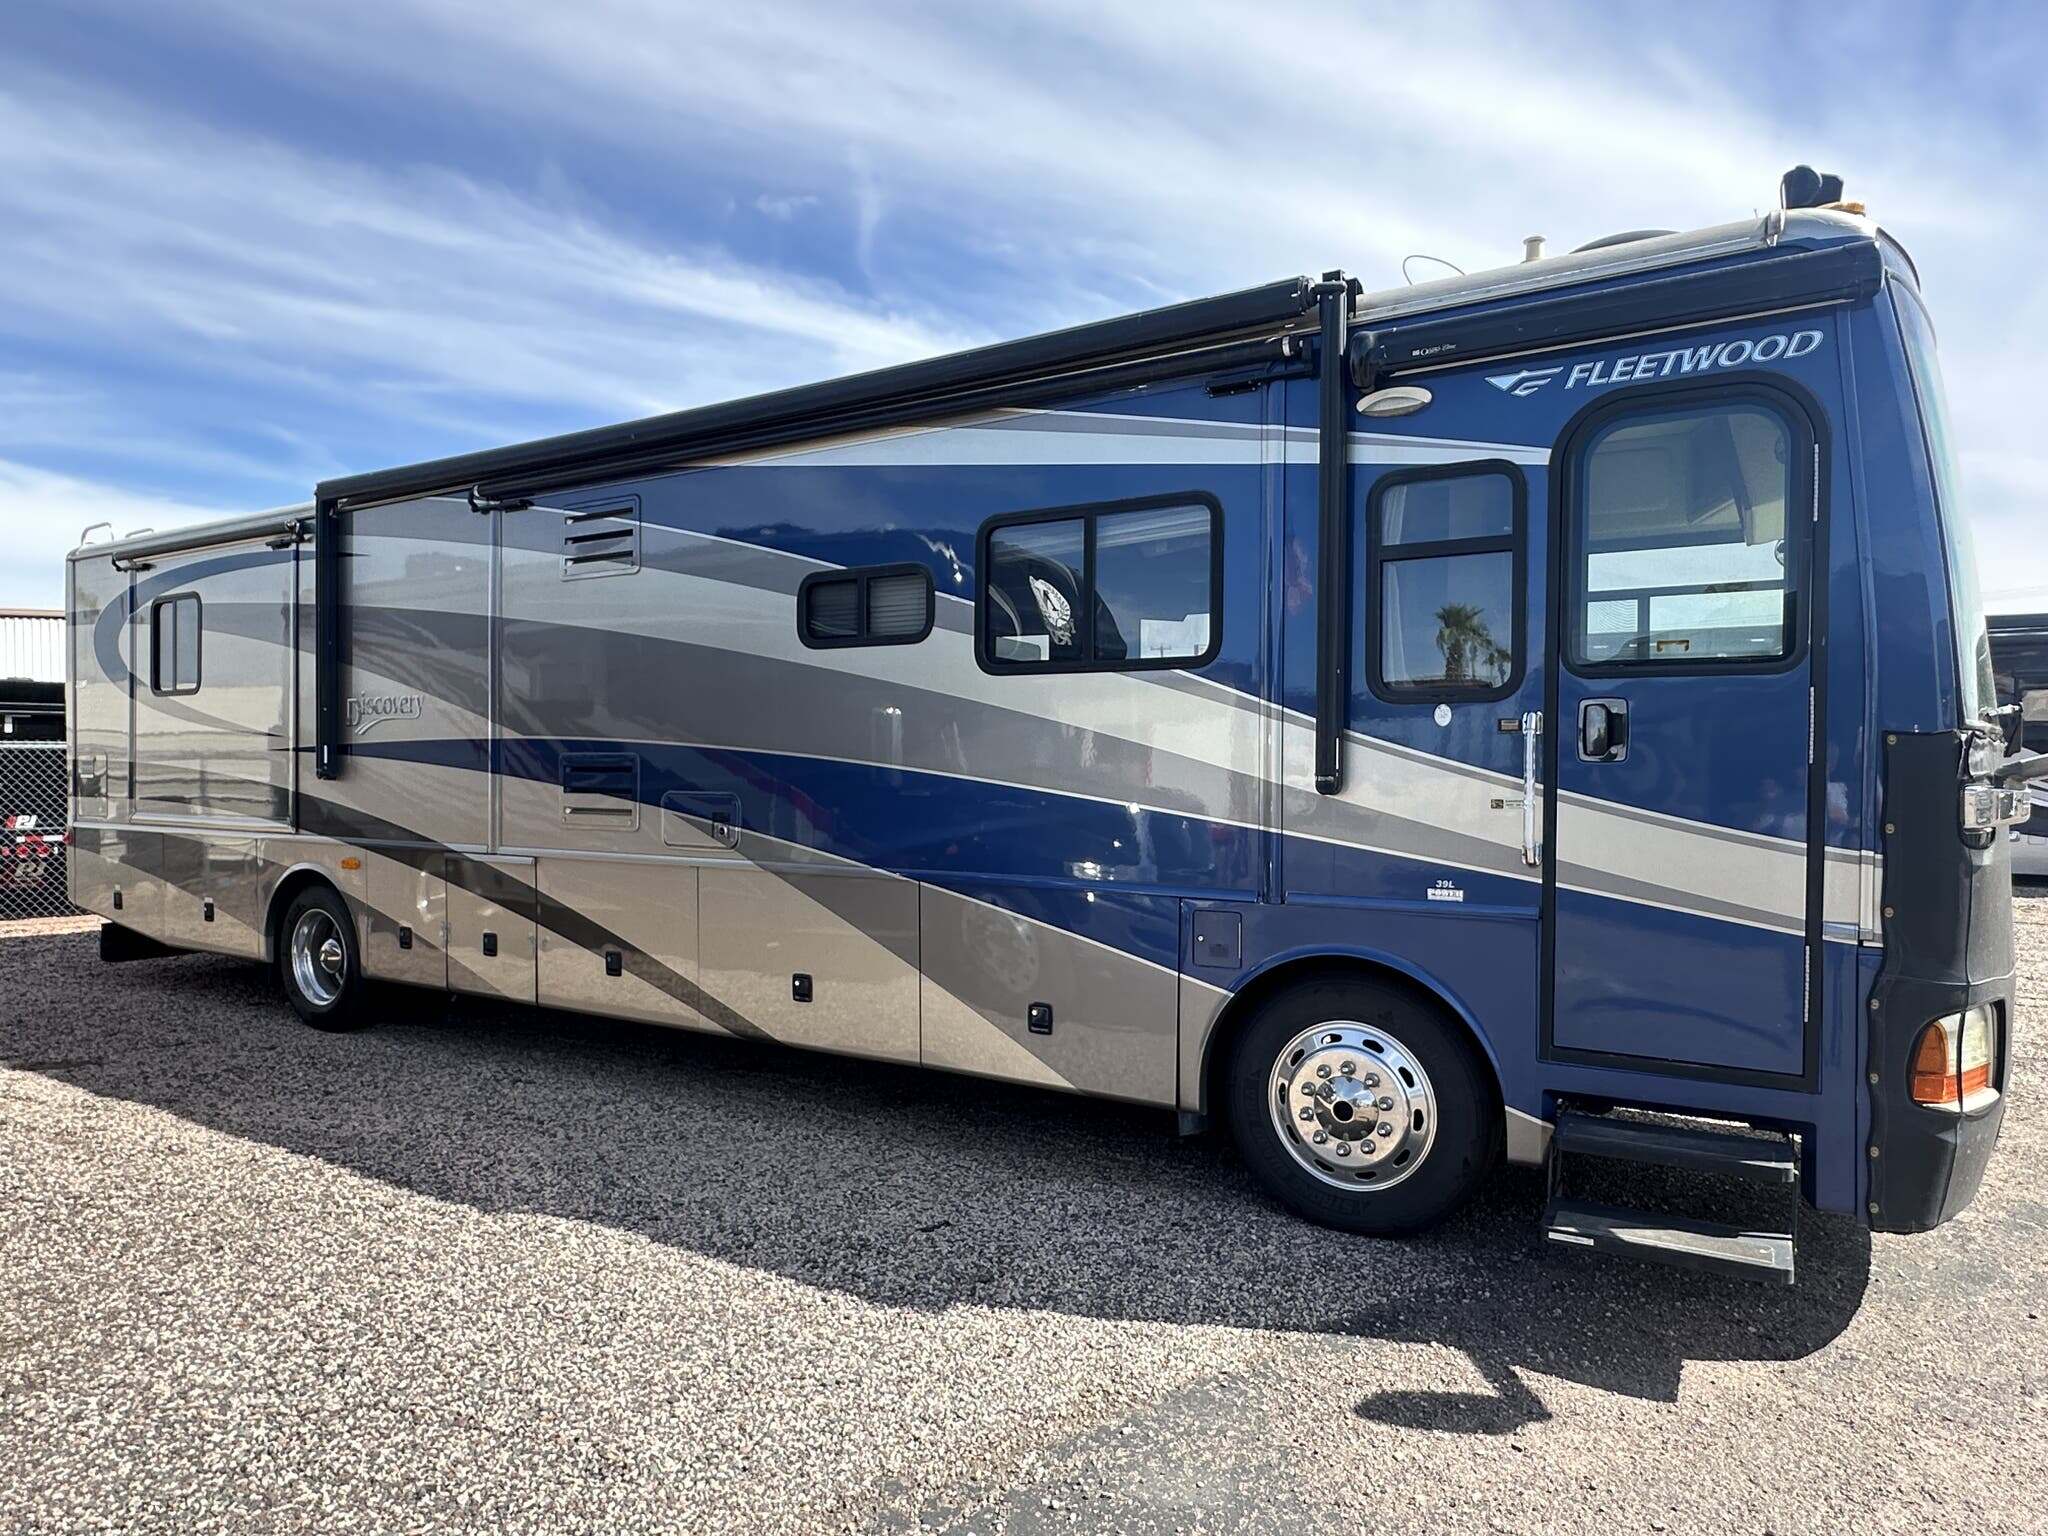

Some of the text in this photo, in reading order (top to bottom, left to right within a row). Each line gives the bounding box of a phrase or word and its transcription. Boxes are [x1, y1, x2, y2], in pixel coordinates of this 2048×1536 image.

[1564, 329, 1825, 390] FLEETWOOD
[345, 690, 424, 728] Discovery
[1435, 880, 1455, 888] 39L
